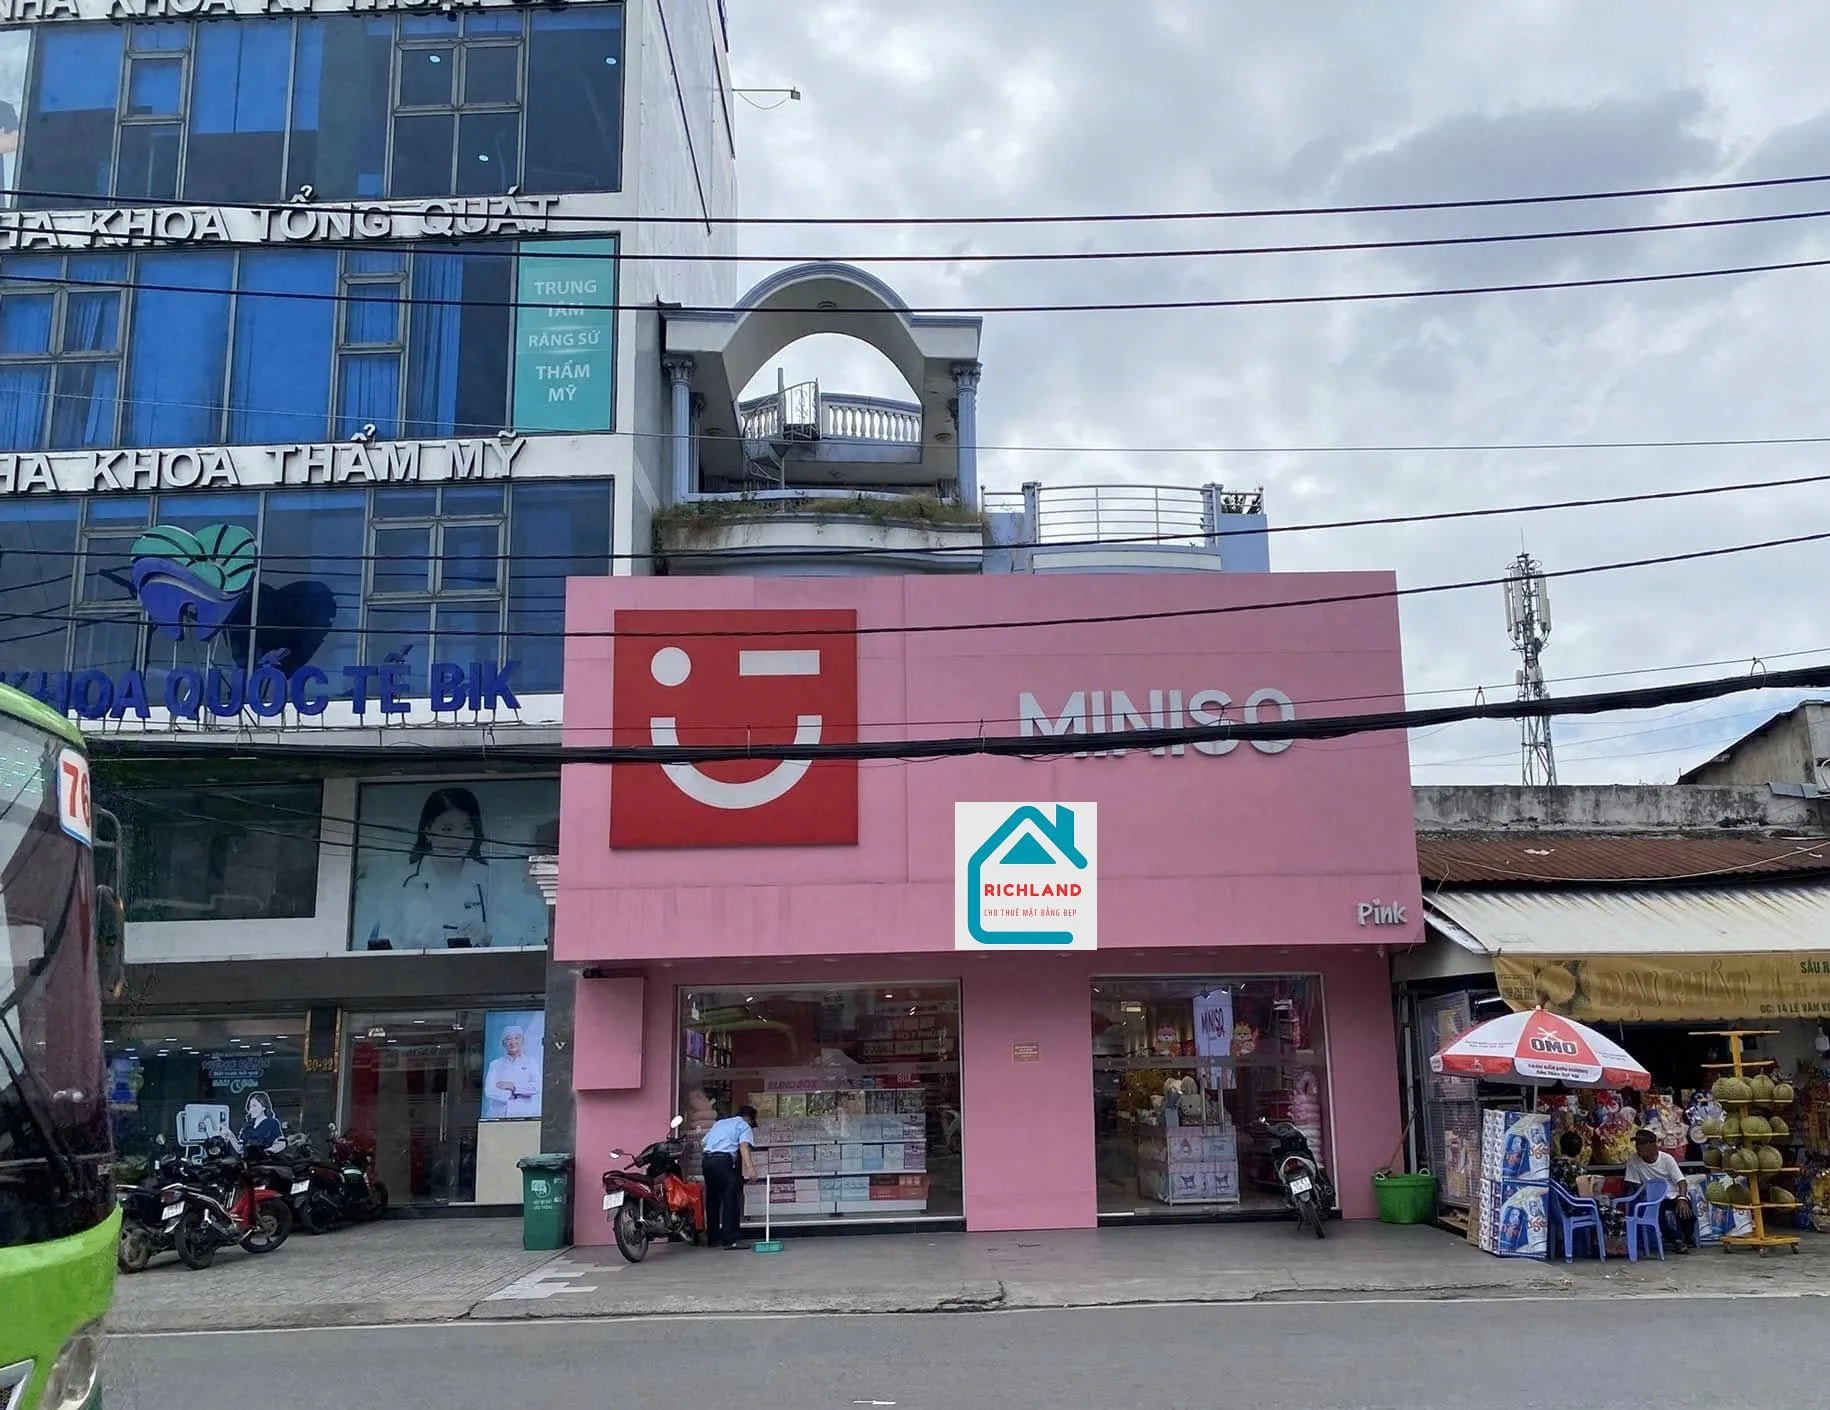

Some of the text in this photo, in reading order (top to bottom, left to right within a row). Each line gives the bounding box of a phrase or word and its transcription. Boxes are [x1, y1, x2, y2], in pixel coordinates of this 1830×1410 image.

[87, 207, 232, 247] KHOA
[250, 184, 393, 242] TỔNG
[420, 185, 558, 238] QUÁT
[533, 280, 597, 296] TRUNG
[577, 329, 601, 346] SỨ
[547, 384, 578, 402] MỸ
[87, 448, 241, 489] KHOA
[264, 423, 422, 485] THẨM
[445, 430, 527, 480] MỸ
[164, 648, 329, 720] QUỐC
[343, 643, 413, 716] TẾ
[430, 660, 522, 712] BIK
[1018, 687, 1297, 759] MINISO
[1356, 898, 1408, 926] Pink
[1530, 1037, 1577, 1056] OMO
